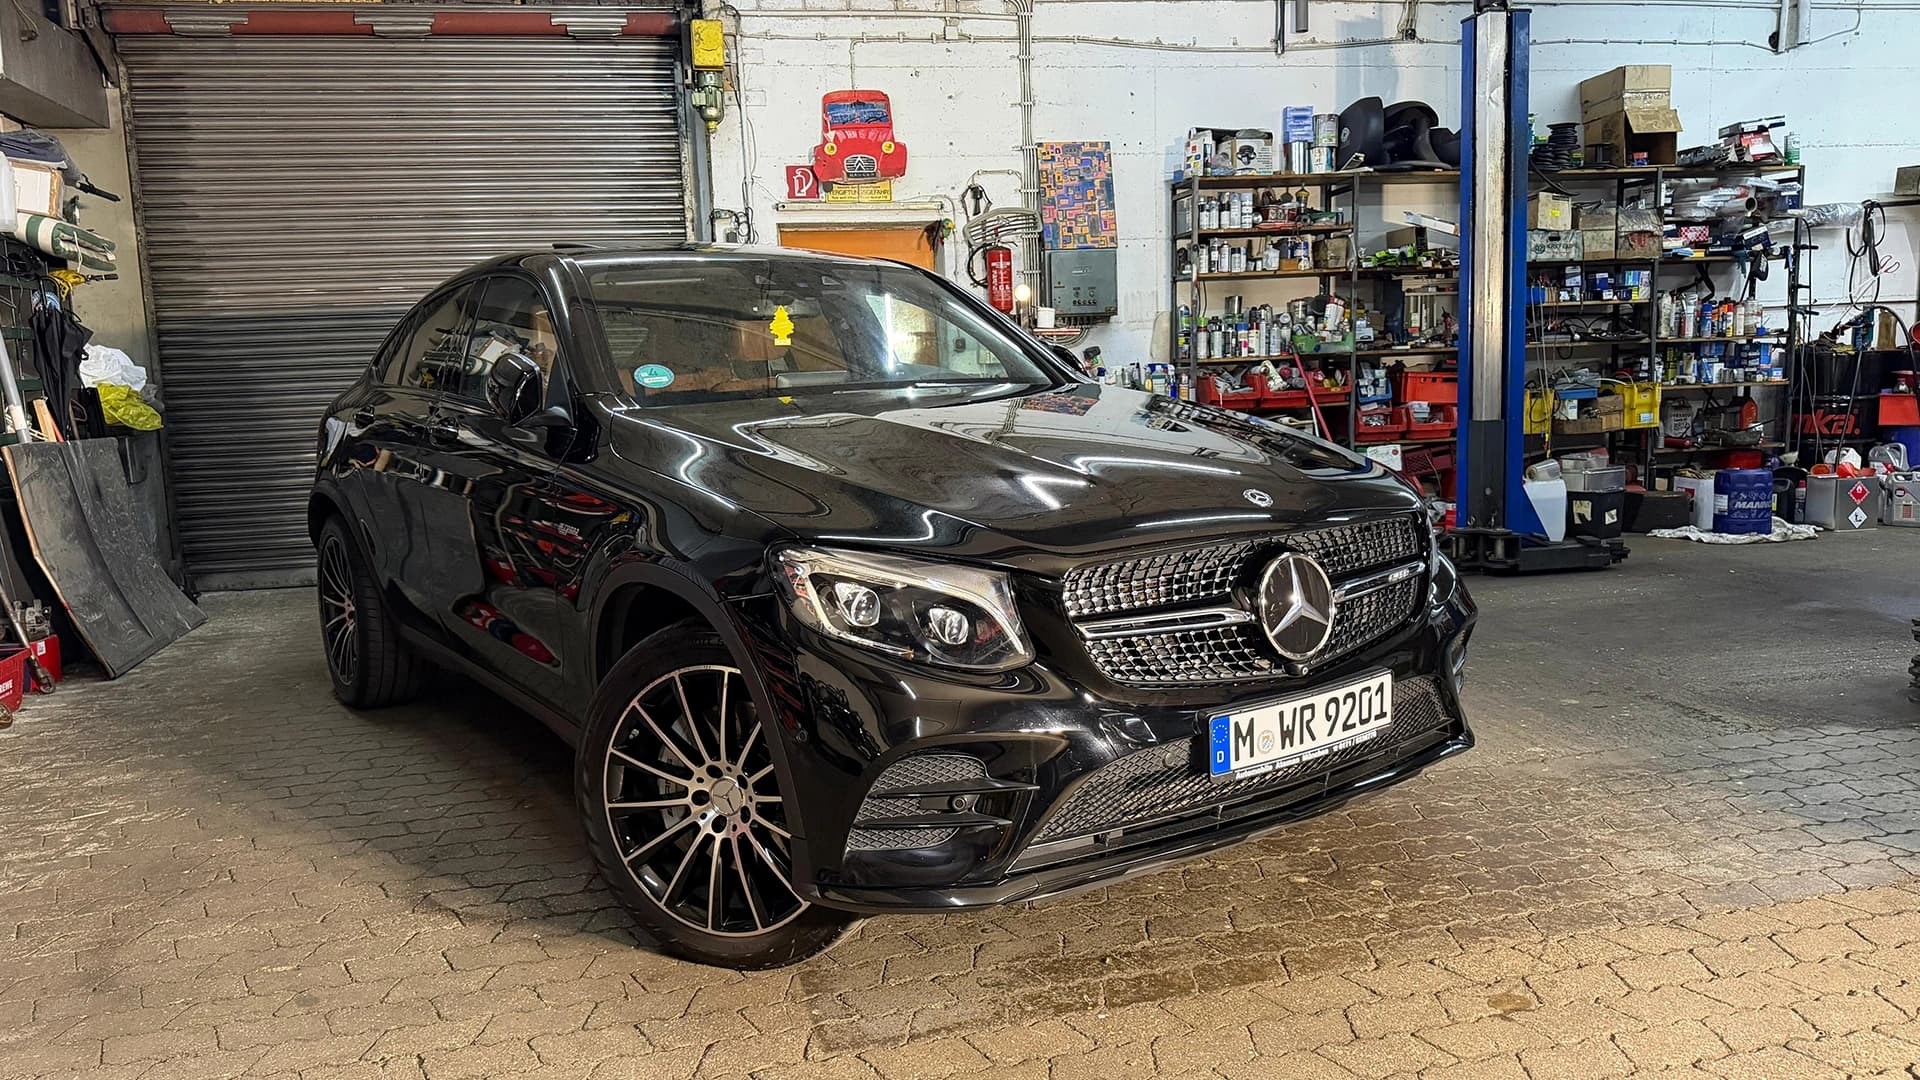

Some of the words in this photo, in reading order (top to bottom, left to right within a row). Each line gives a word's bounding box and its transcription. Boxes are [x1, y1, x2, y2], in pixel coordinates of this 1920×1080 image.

[1233, 717, 1255, 762] M
[1278, 702, 1317, 750] WR
[1324, 681, 1388, 737] 9201
[1216, 750, 1225, 763] D
